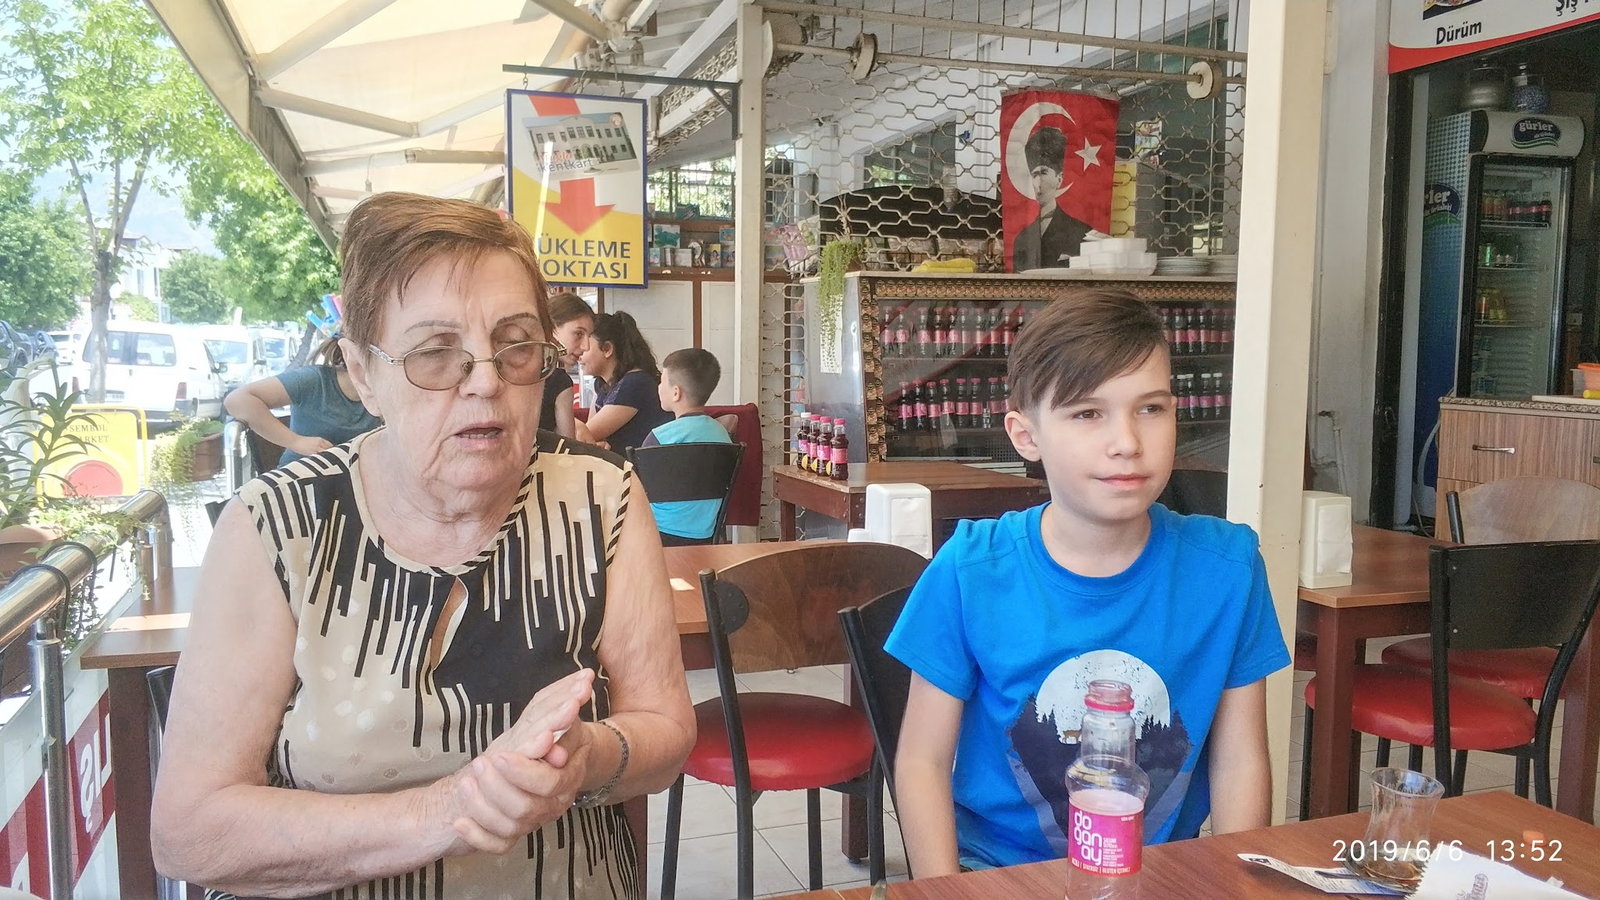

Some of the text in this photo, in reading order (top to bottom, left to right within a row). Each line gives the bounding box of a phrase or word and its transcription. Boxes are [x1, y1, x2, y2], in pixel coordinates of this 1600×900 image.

[1436, 21, 1482, 45] Dürüm
[1519, 120, 1554, 132] gürler
[538, 159, 594, 173] kentkart
[538, 233, 631, 259] ÜKLEME
[543, 259, 627, 280] OKTASI
